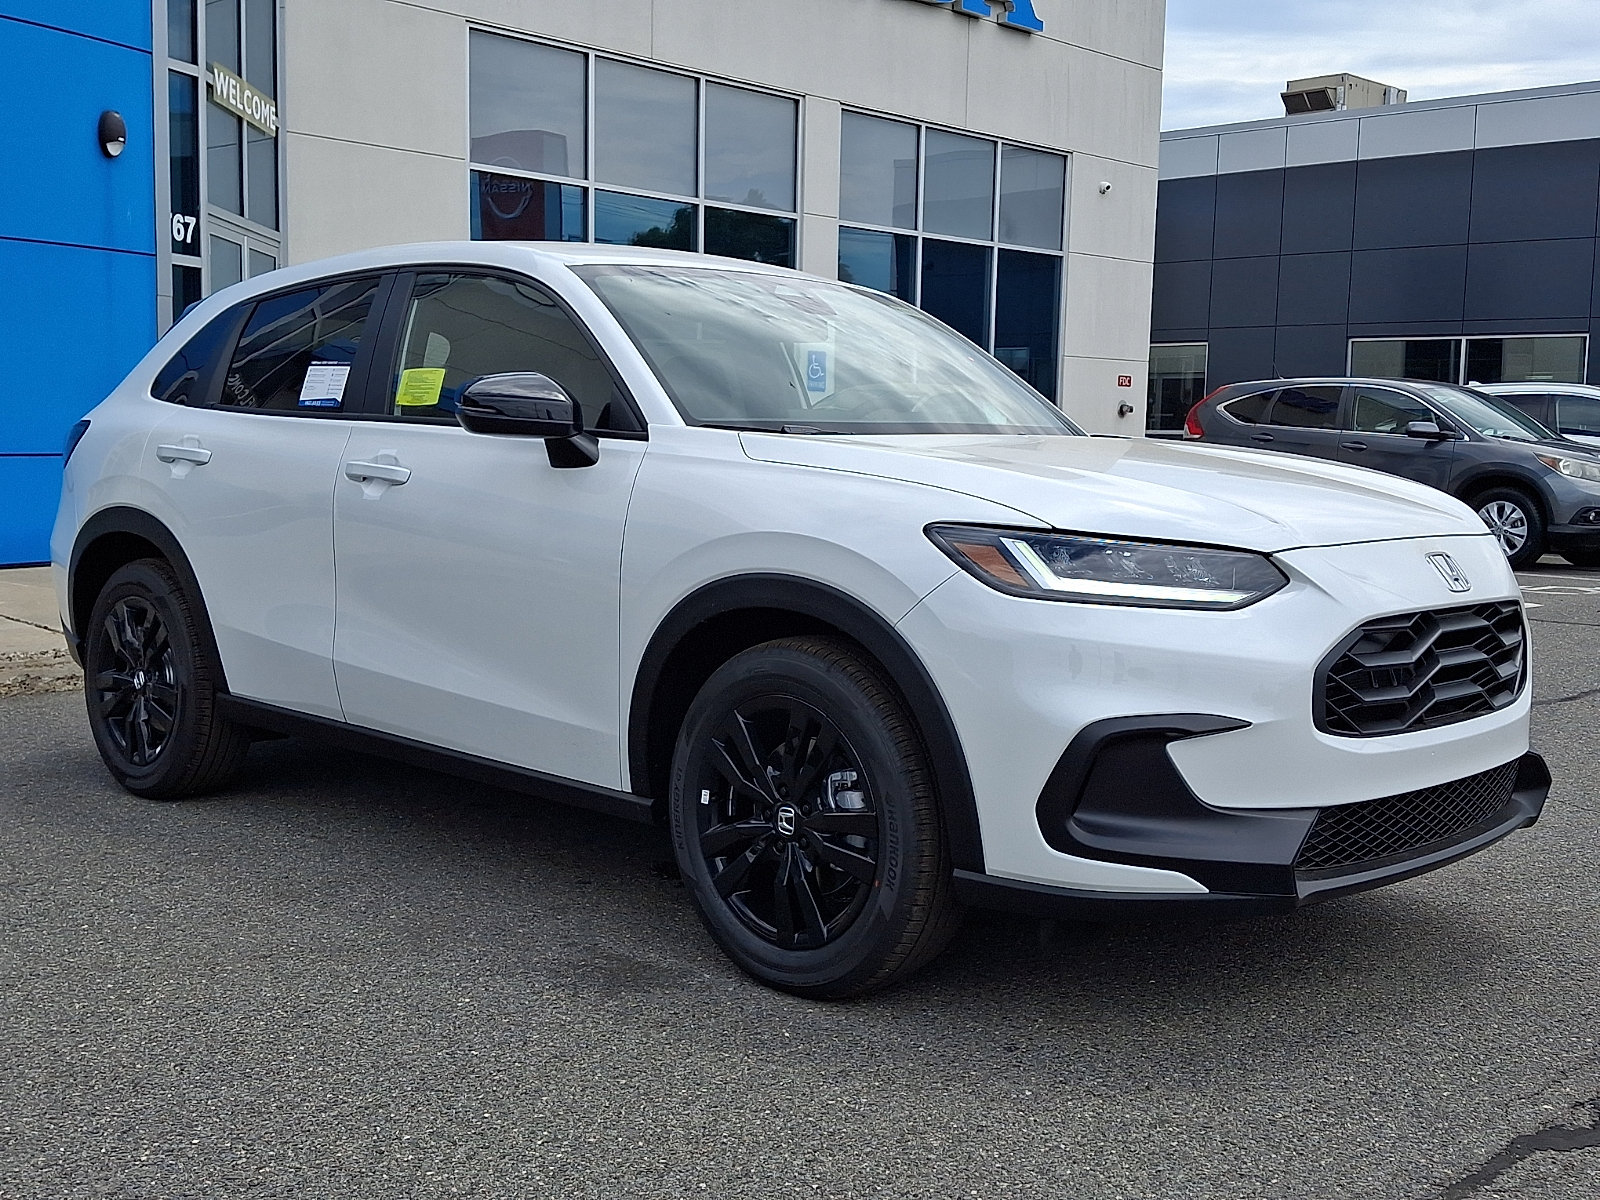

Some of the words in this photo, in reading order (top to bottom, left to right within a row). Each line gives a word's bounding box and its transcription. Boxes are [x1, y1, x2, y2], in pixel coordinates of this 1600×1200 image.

[213, 67, 276, 131] WELCOME
[170, 213, 197, 244] 67
[1119, 376, 1131, 386] FDC
